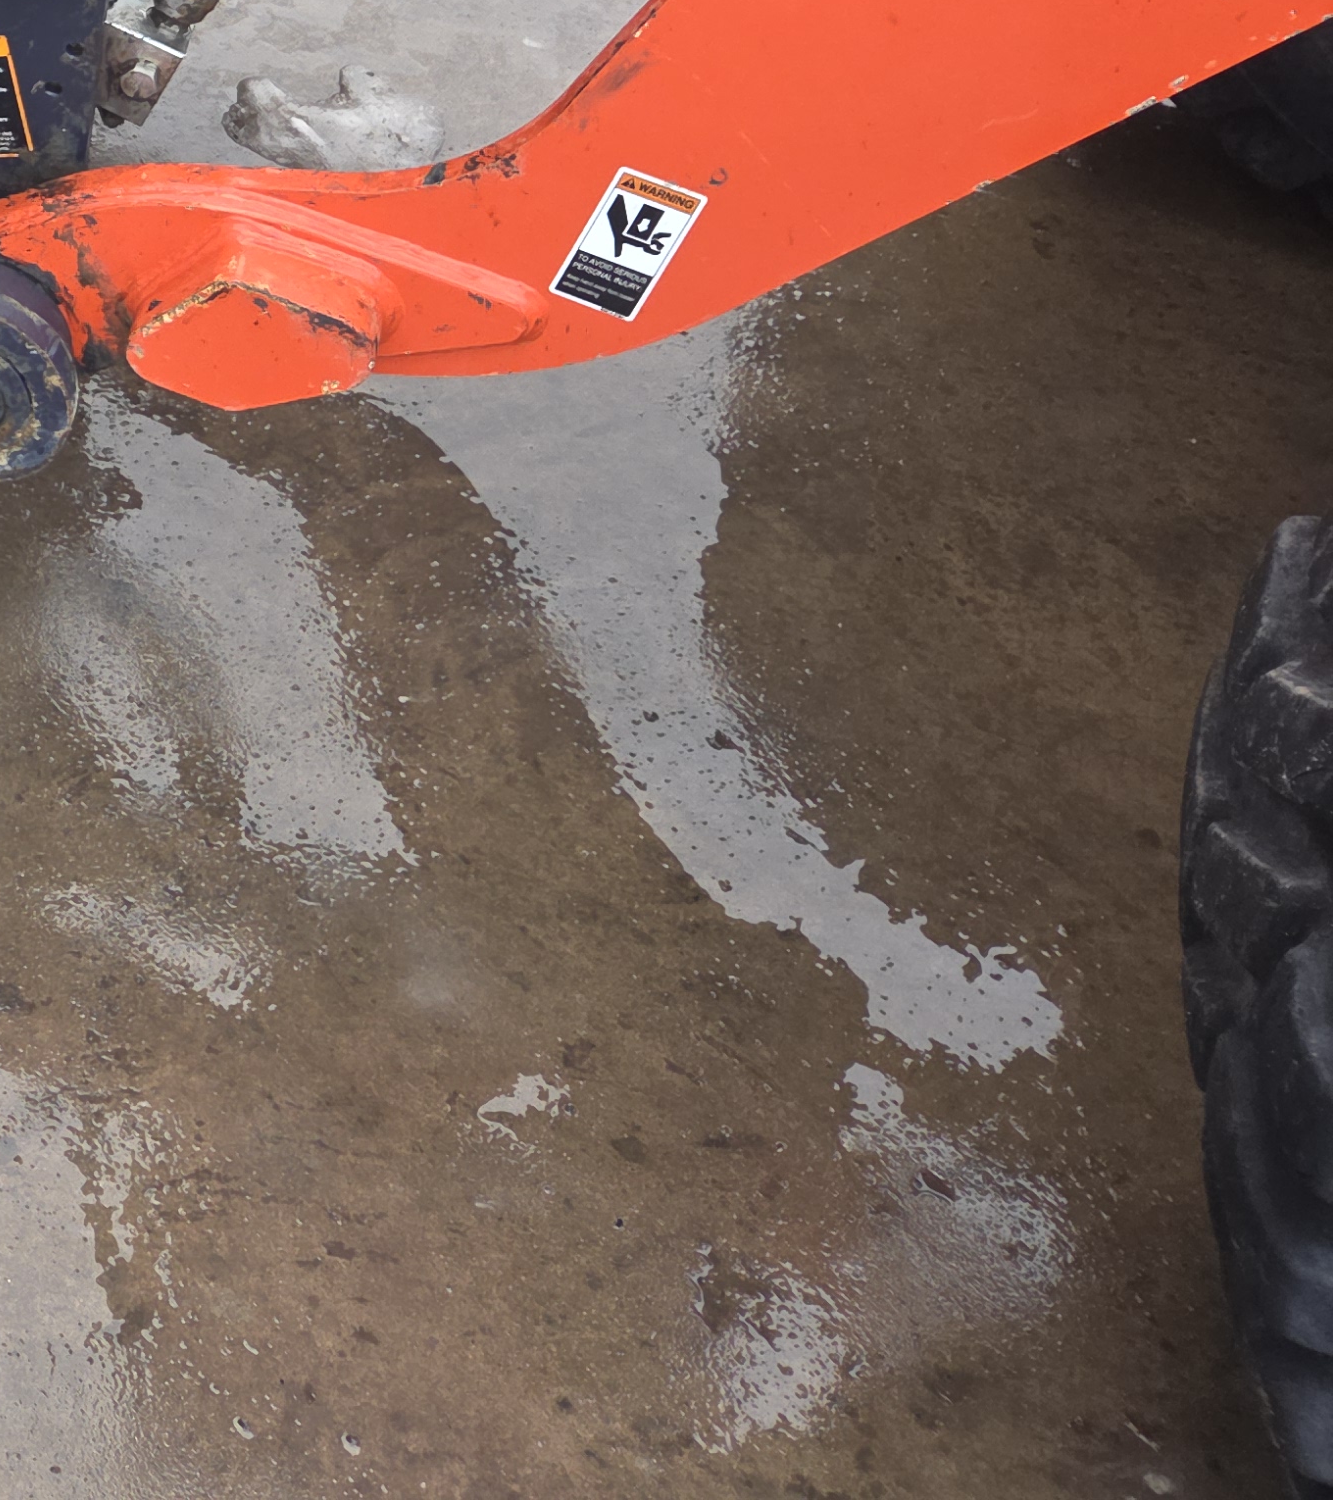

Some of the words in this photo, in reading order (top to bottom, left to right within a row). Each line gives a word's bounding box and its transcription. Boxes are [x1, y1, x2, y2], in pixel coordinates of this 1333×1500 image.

[639, 181, 695, 210] WARNING
[572, 261, 612, 282] PERSONAL
[578, 253, 589, 262] TO
[589, 258, 613, 271] AVOID
[613, 267, 648, 285] SERIOUS
